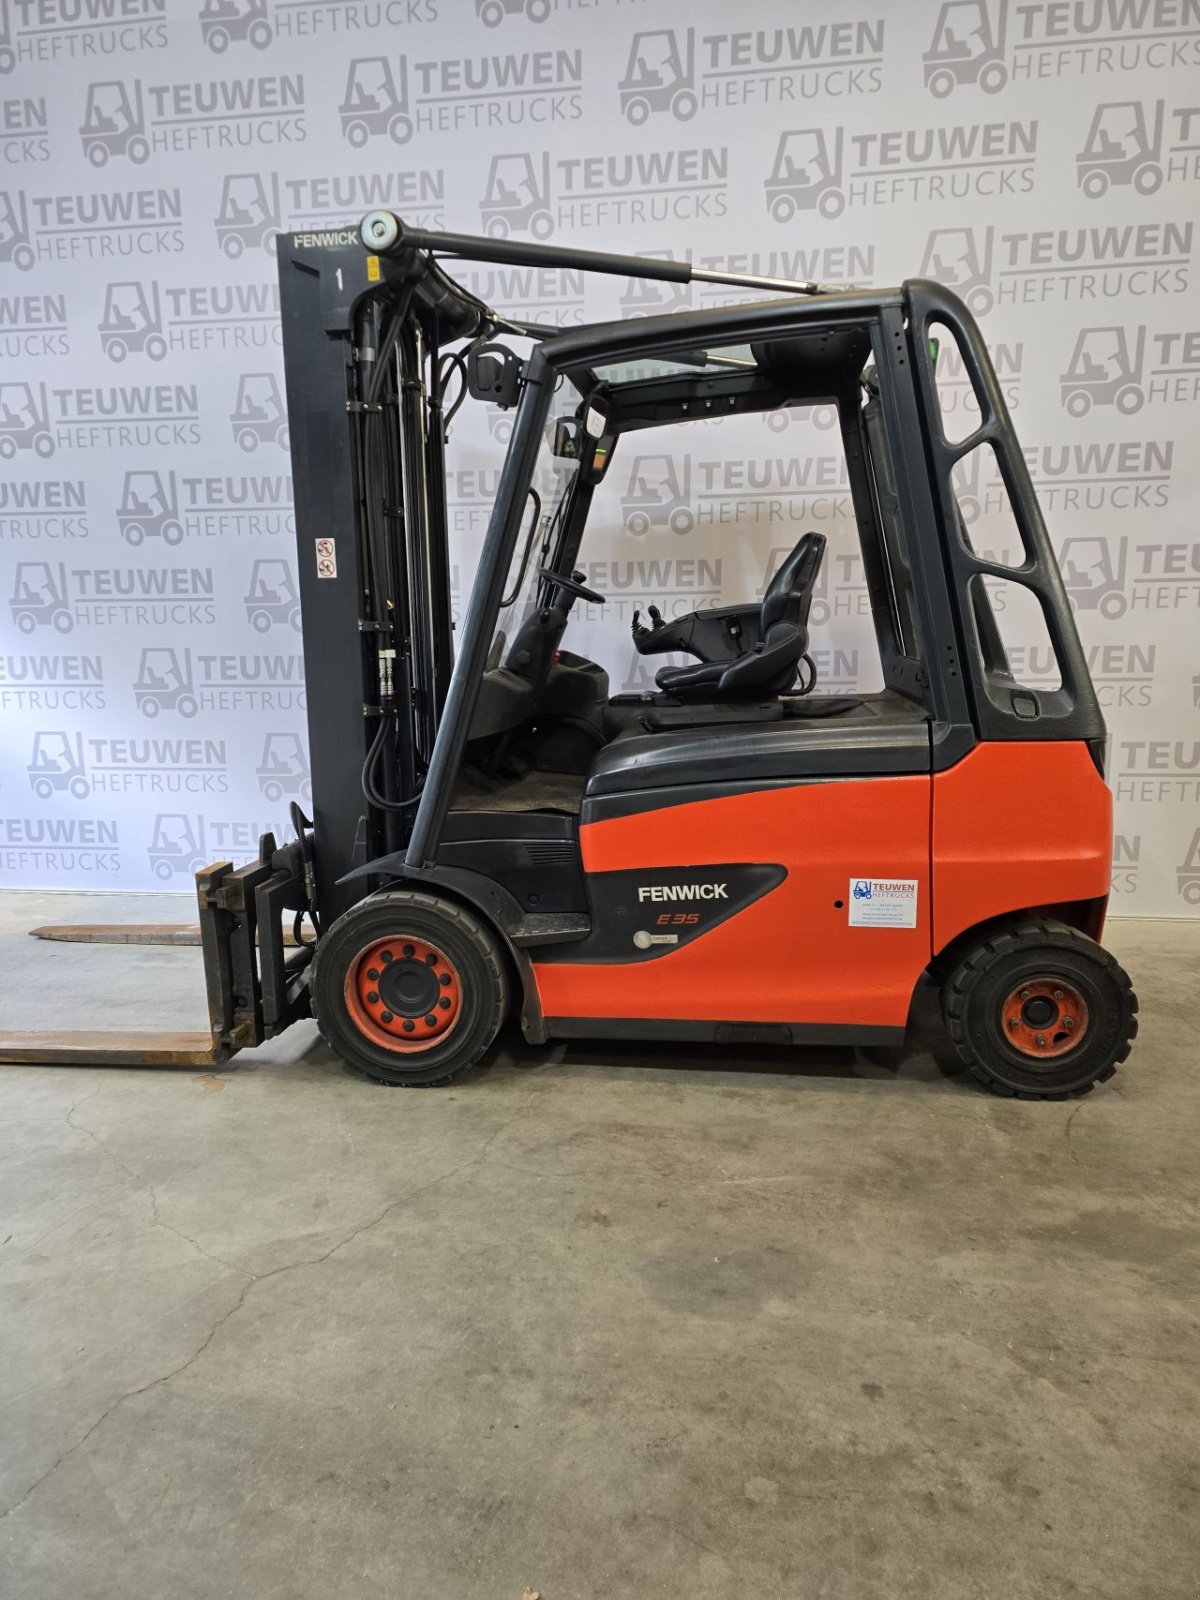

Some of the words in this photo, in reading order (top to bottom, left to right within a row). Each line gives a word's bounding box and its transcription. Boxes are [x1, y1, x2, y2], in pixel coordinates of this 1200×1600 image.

[275, 0, 438, 37] HEFTRUCKS
[17, 25, 168, 62] HEFTRUCKS
[702, 19, 885, 67] TEUWEN
[415, 49, 582, 93] TEUWEN
[149, 74, 305, 116] TEUWEN
[702, 67, 882, 107] HEFTRUCKS
[416, 96, 582, 132] HEFTRUCKS
[152, 119, 306, 152] HEFTRUCKS
[851, 120, 1038, 167] TEUWEN
[557, 147, 728, 190] TEUWEN
[285, 169, 445, 209] TEUWEN
[849, 167, 1034, 206] HEFTRUCKS
[33, 188, 182, 226] TEUWEN
[557, 193, 727, 228] HEFTRUCKS
[36, 231, 184, 260] HEFTRUCKS
[294, 231, 358, 249] FENWICK
[1001, 222, 1193, 266] TEUWEN
[166, 285, 280, 316] TEUW
[998, 268, 1189, 304] HEFTRUCKS
[0, 295, 66, 325] WEN
[169, 325, 283, 351] HEFTRUC
[52, 385, 199, 416] TEUWEN
[56, 424, 200, 449] HEFTRUCKS
[0, 481, 86, 508] WEN
[182, 476, 294, 505] TEUW
[984, 485, 1169, 515] HTRUCKS
[697, 497, 855, 525] HEFTRUCK
[186, 515, 296, 538] HEFTRUC
[72, 568, 213, 595] TEUWEN
[75, 604, 215, 625] HEFTRUCKS
[198, 656, 305, 680] TEUW
[1, 691, 106, 710] FTRUCKS
[200, 691, 306, 711] HEFTRUC
[89, 739, 226, 764] TEUWEN
[91, 774, 228, 793] HEFTRUCKS
[638, 884, 728, 902] FENWICK
[873, 883, 914, 891] TEUWEN
[656, 914, 672, 925] E
[672, 913, 699, 924] 35
